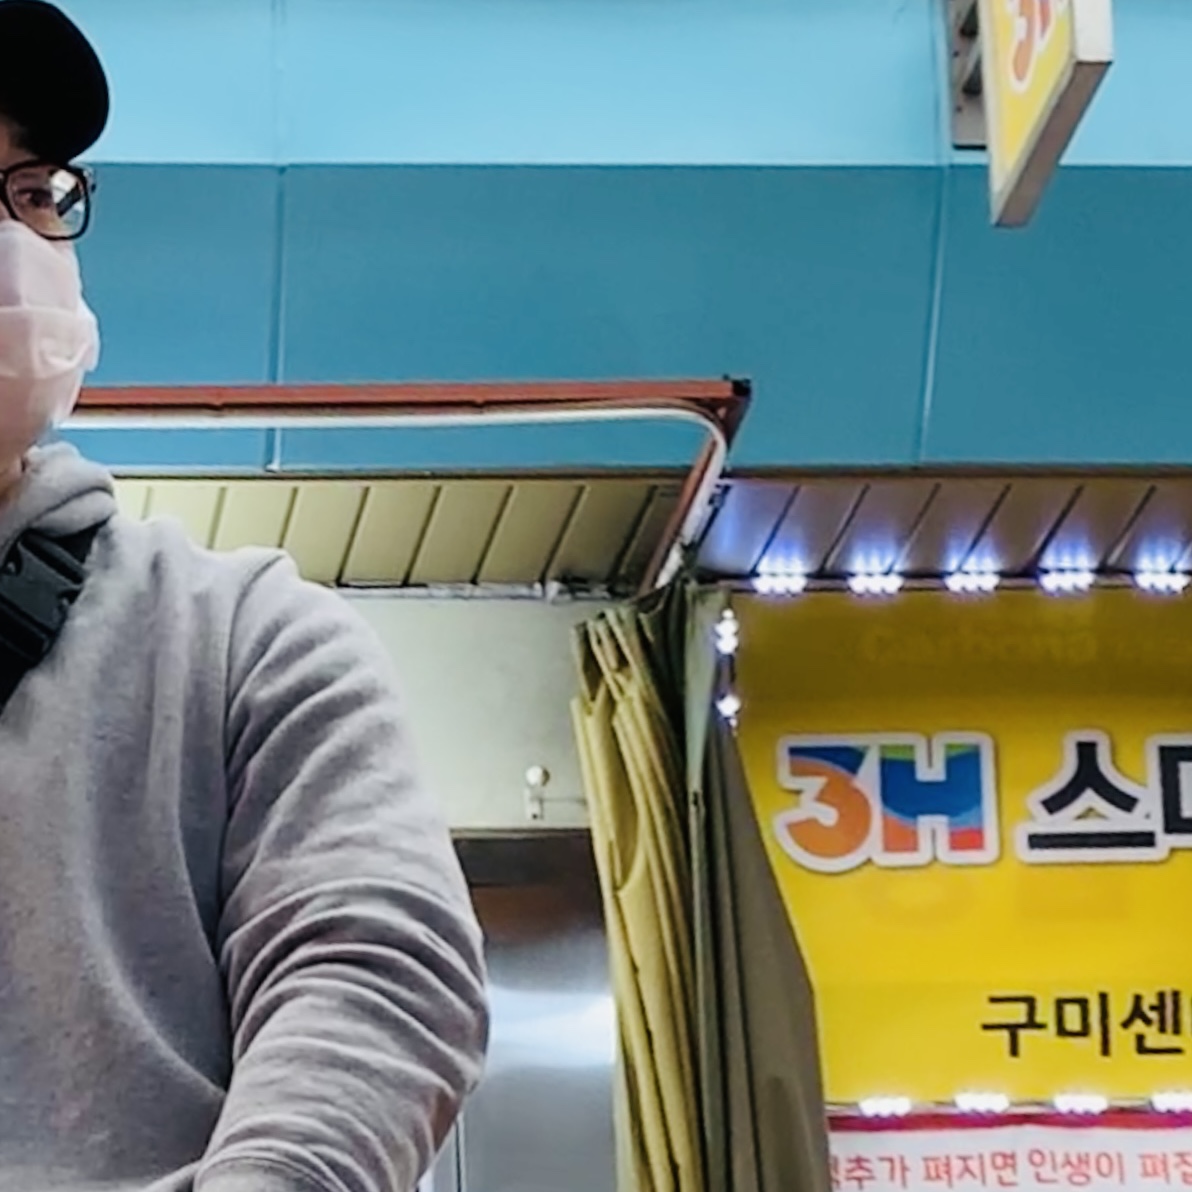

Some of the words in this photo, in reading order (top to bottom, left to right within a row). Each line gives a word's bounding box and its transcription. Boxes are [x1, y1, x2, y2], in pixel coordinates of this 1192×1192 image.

[784, 742, 986, 860] 3H
[980, 989, 1192, 1057] 구미센
[1025, 1147, 1126, 1187] 인생이
